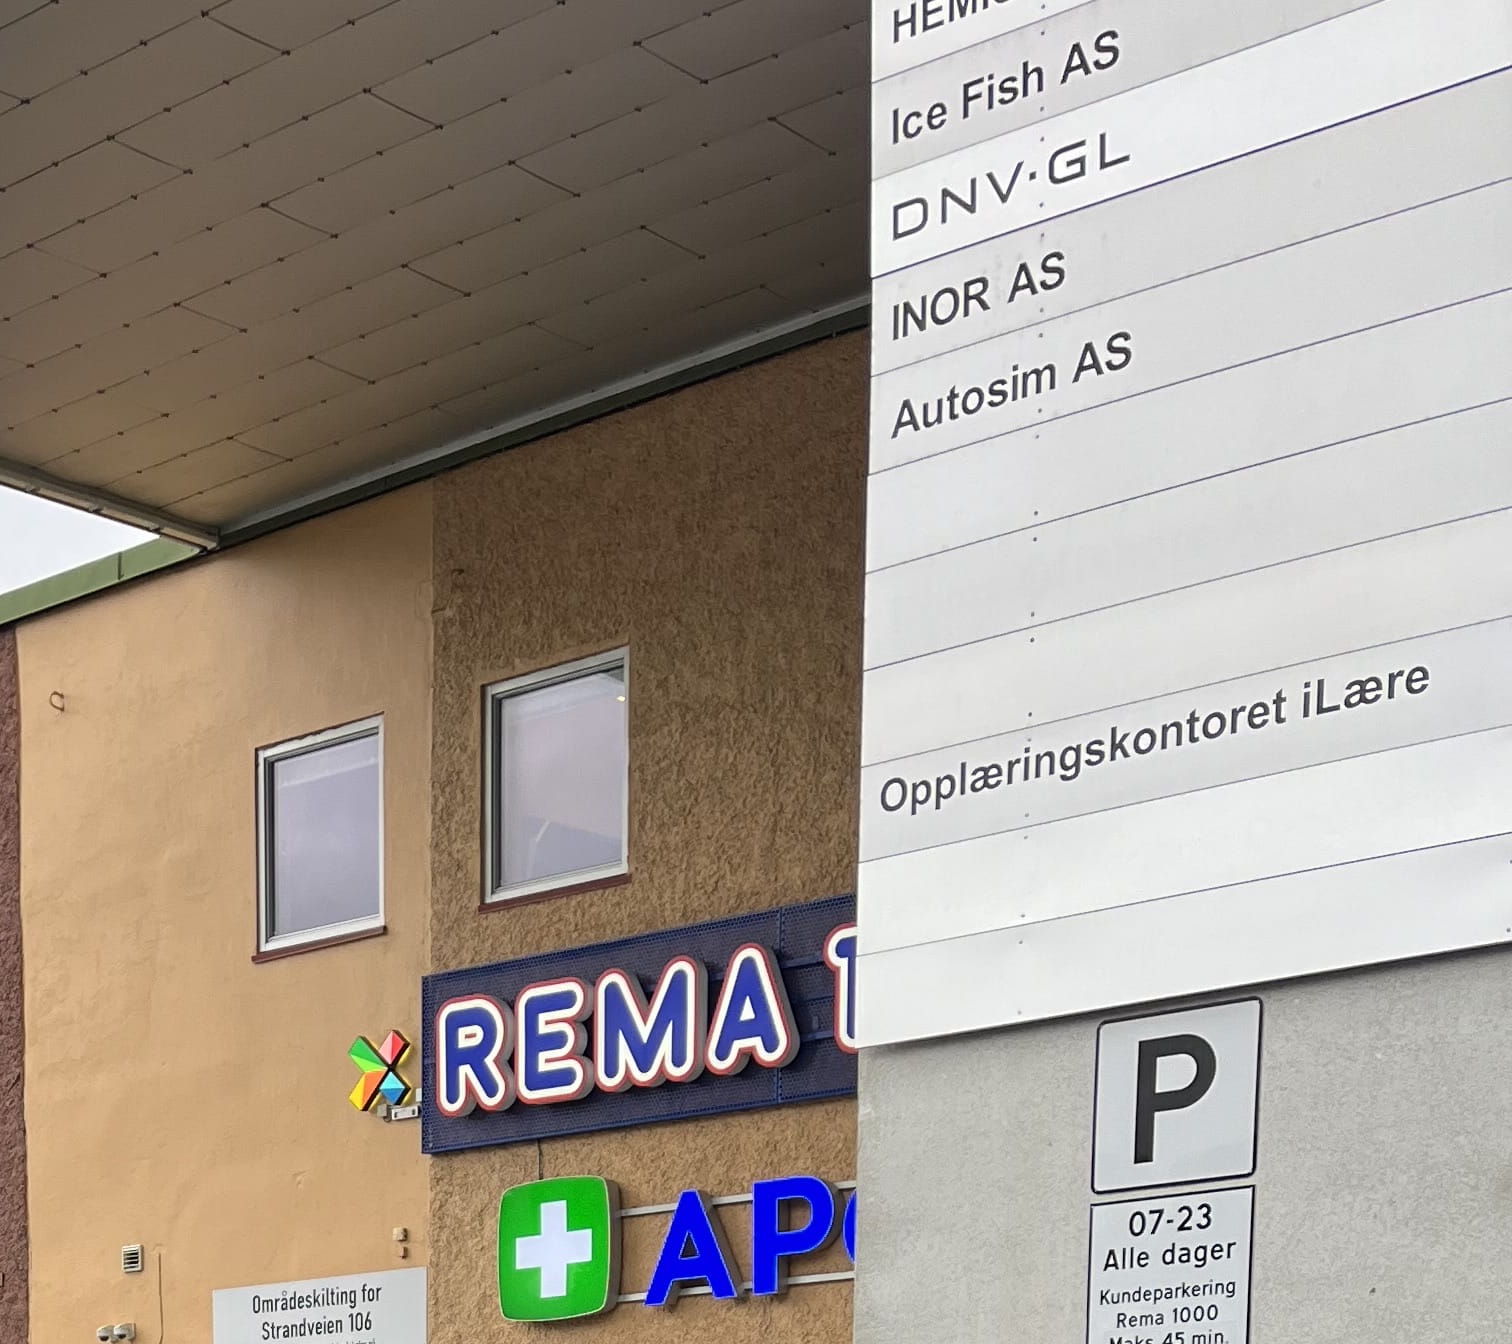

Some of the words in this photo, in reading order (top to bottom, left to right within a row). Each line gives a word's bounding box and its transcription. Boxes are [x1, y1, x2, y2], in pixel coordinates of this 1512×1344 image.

[892, 102, 948, 145] Ice
[962, 61, 1045, 120] Fish
[1060, 30, 1120, 85] AS
[892, 276, 990, 341] INOR
[1007, 251, 1066, 303] AS
[891, 363, 1056, 439] Autosim
[1072, 331, 1132, 383] AS
[879, 689, 1288, 816] Opplæringskontoret
[1301, 665, 1431, 719] iLære
[434, 942, 794, 1117] REMA
[1133, 1033, 1217, 1165] P
[644, 1175, 857, 1308] AP
[1103, 1247, 1150, 1271] Alle
[1161, 1239, 1237, 1271] dager
[1128, 1203, 1212, 1237] 07-23
[252, 1289, 357, 1314] Områdeskilting
[361, 1283, 383, 1302] for
[262, 1315, 343, 1340] Strandveien
[348, 1311, 372, 1332] 106
[1099, 1279, 1236, 1306] Kundeparkering
[1116, 1311, 1165, 1328] Rema
[1172, 1305, 1219, 1324] 1000
